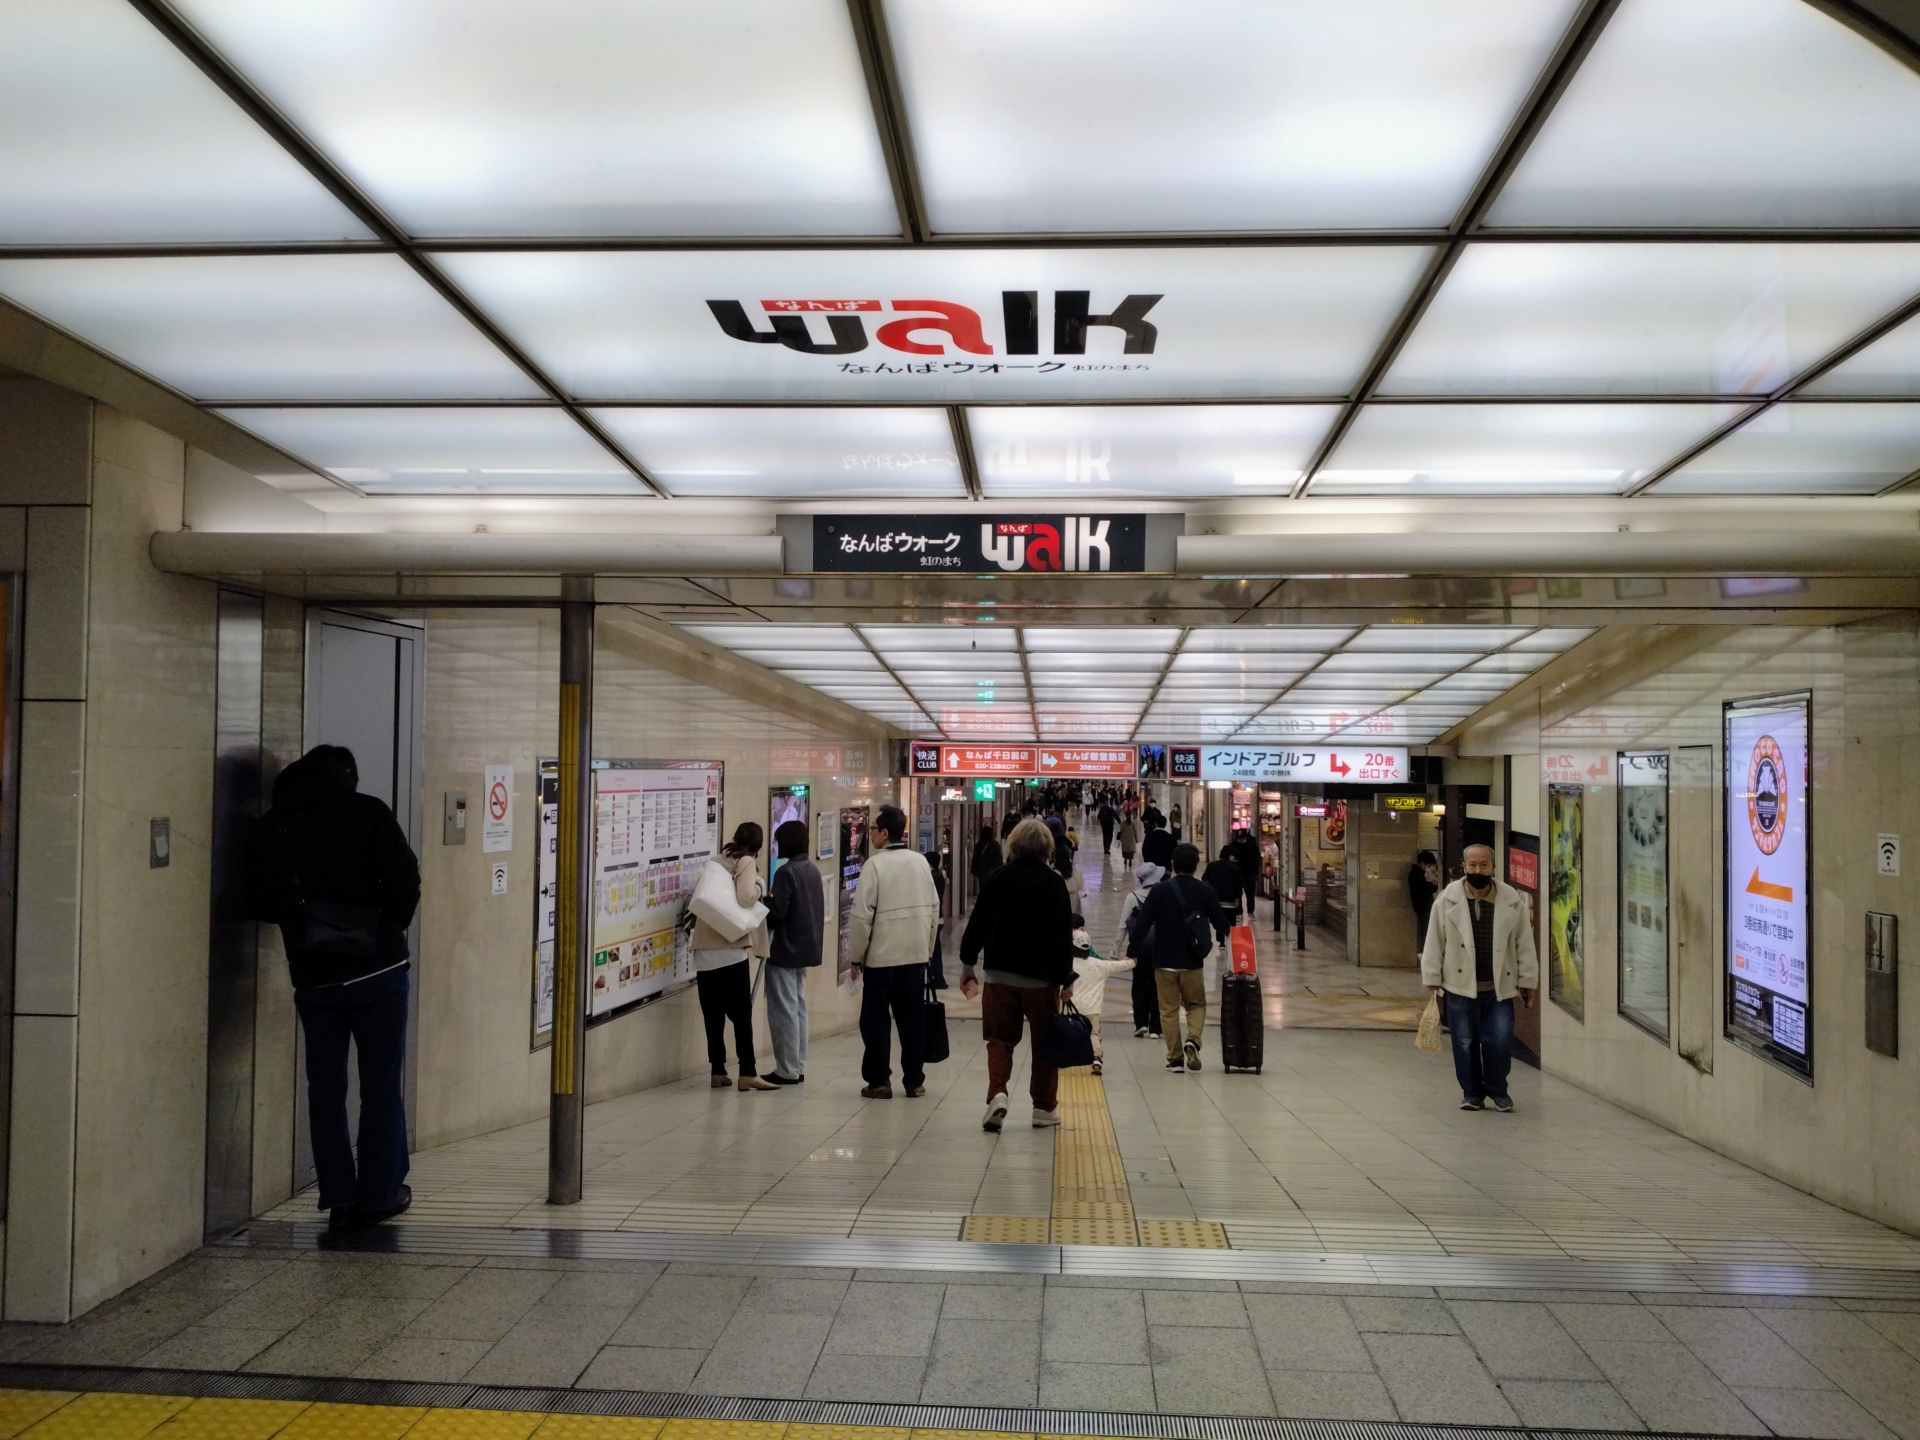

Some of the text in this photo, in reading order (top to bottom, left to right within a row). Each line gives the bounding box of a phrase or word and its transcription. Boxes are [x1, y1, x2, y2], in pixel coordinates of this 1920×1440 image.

[776, 300, 868, 311] なんば
[837, 361, 1150, 374] なんばウォーク 虹のまち
[999, 523, 1030, 533] なんば
[839, 532, 962, 553] なんばウォーク
[920, 555, 962, 567] 虹のまち
[917, 750, 937, 761] 快活
[965, 750, 1029, 761] なんば千日前店
[1063, 752, 1127, 762] なんば御堂筋店
[1174, 753, 1196, 764] 快活
[1207, 751, 1316, 767] インドアゴルフ
[1364, 752, 1396, 767] 20番
[917, 760, 937, 769] CLUB
[1174, 764, 1196, 773] CLUB
[1232, 769, 1292, 777] 24時間 年中無休
[1358, 767, 1401, 779] 出口すぐ
[1386, 797, 1424, 806] サンマルコ
